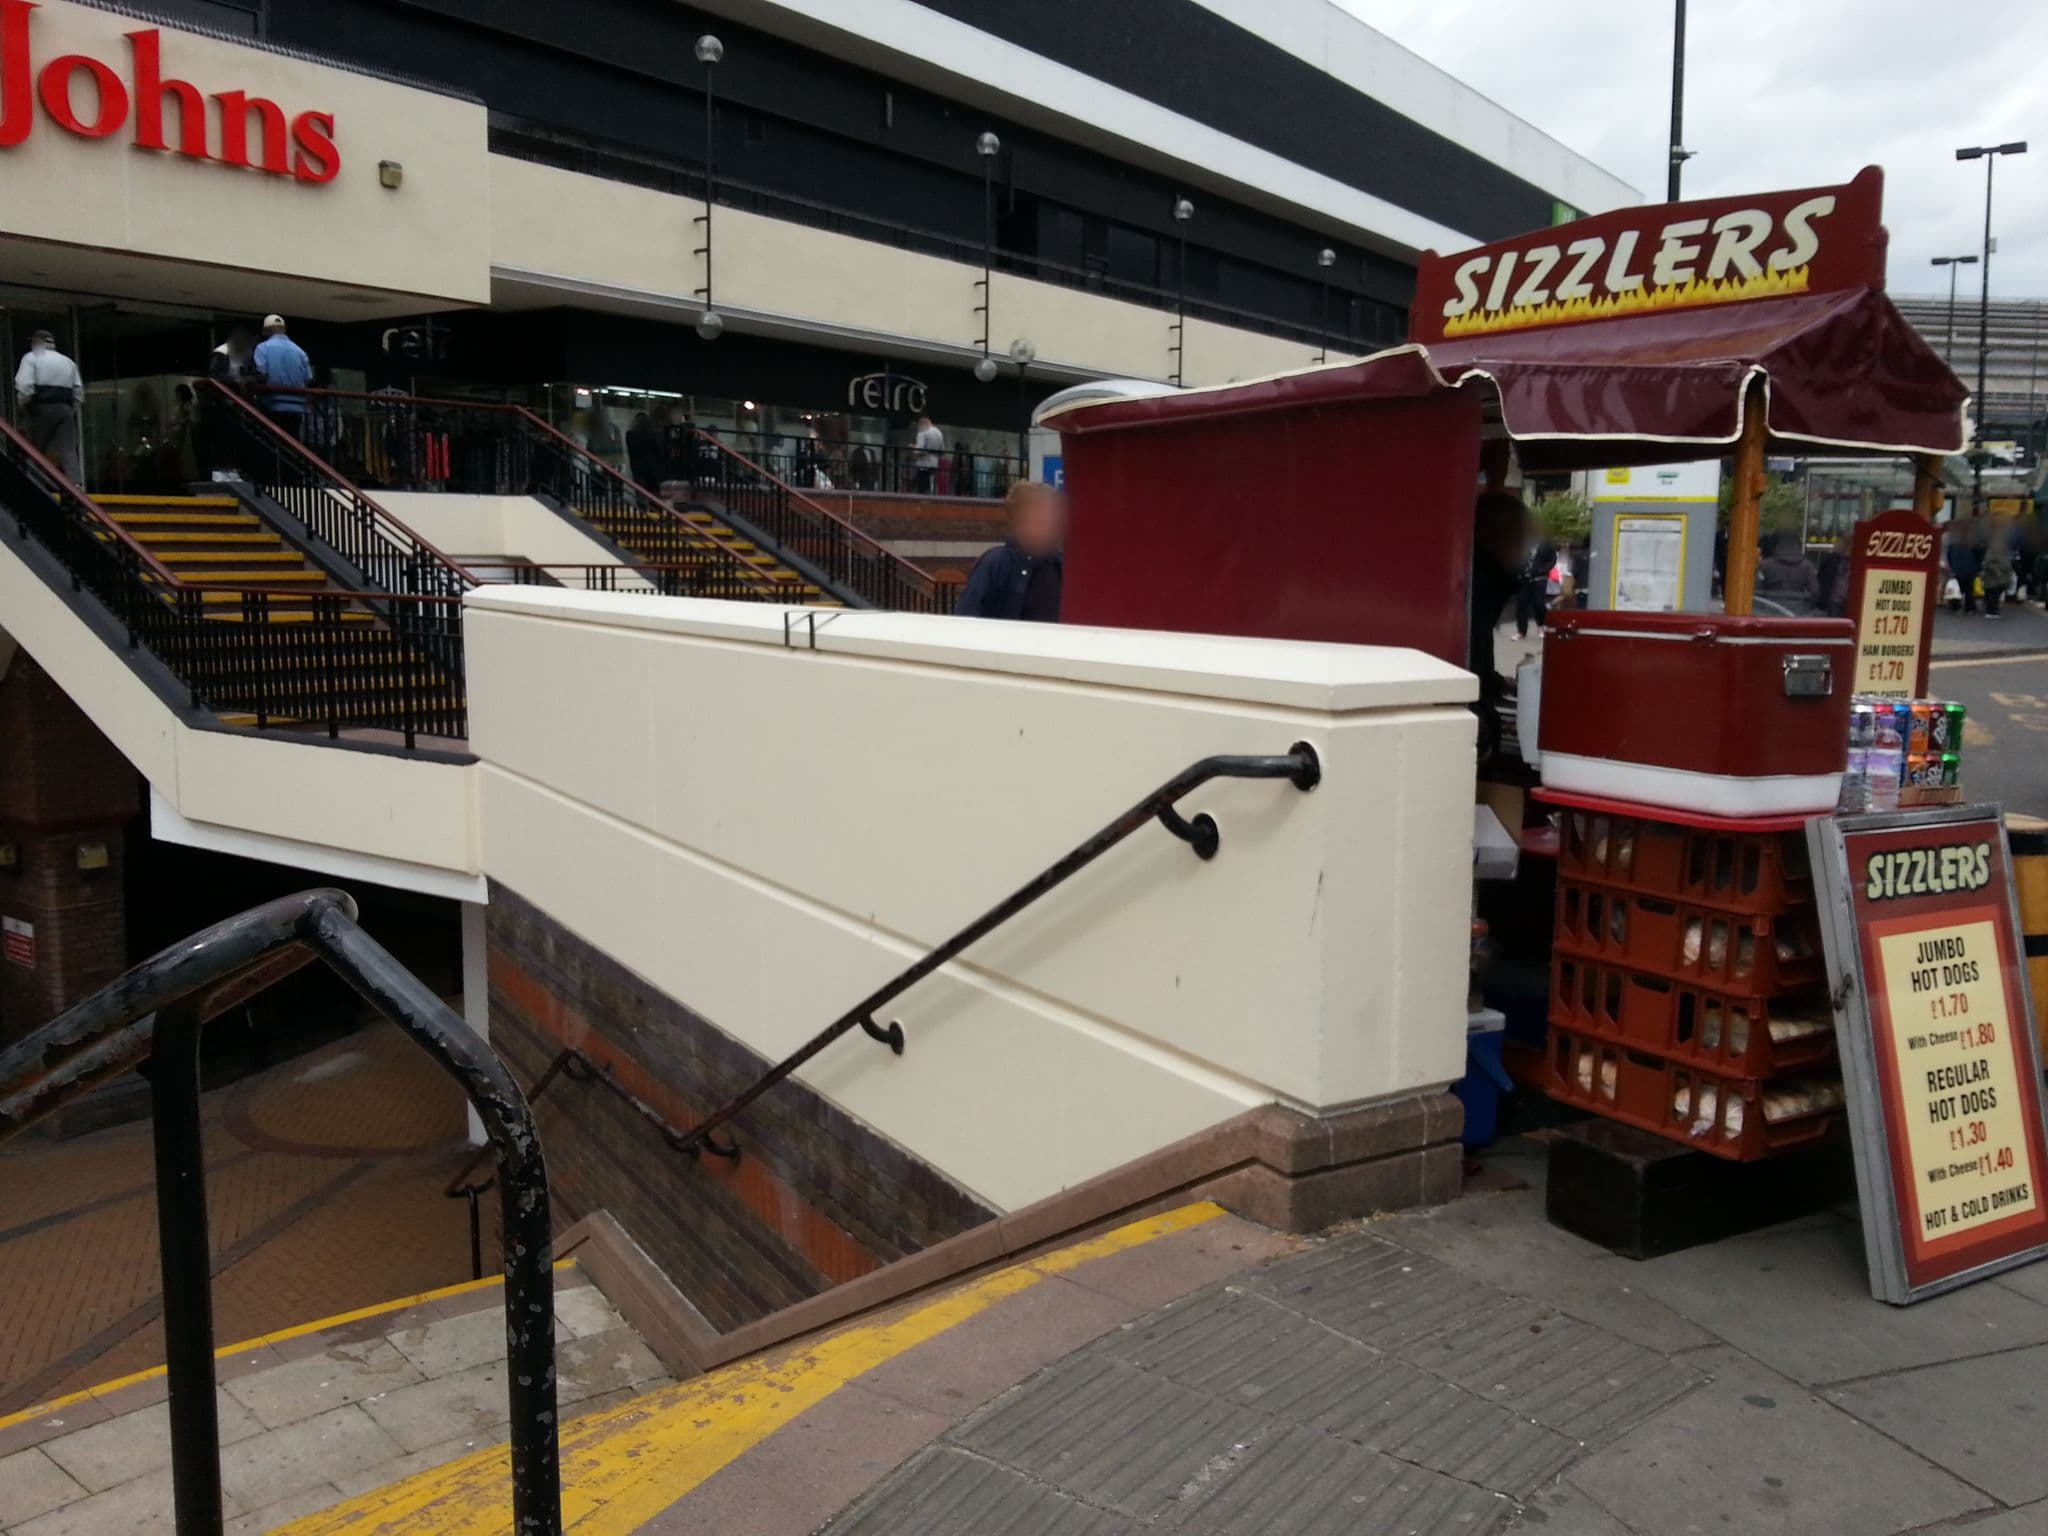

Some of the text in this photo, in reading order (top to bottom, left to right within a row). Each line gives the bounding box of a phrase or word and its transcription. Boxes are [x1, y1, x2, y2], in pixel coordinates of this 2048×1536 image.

[0, 0, 341, 184] Johns
[1443, 196, 1836, 317] SIZZLERS
[848, 368, 928, 413] retro
[1866, 531, 1933, 560] SIZZLERS
[1879, 579, 1913, 596] JUMBO
[1875, 599, 1911, 612] HOT DOGS
[1873, 615, 1909, 636] £1.70
[1863, 644, 1915, 657] HAM BURGERS
[1869, 661, 1904, 681] £1.70
[1866, 842, 1991, 900] SIZZLERS
[1917, 936, 1966, 965] JUMBO
[1911, 960, 1980, 993] HOT DOGS
[1931, 992, 1969, 1020] £1.70
[1908, 1021, 1996, 1051] With Cheese £1.80
[1927, 1059, 1991, 1093] REGULAR
[1929, 1087, 1998, 1124] HOT DOGS
[1950, 1120, 1988, 1151] £1.30
[1928, 1146, 2014, 1184] With Cheese £1.40
[1925, 1183, 2030, 1231] HOT & COLD DRINKS
